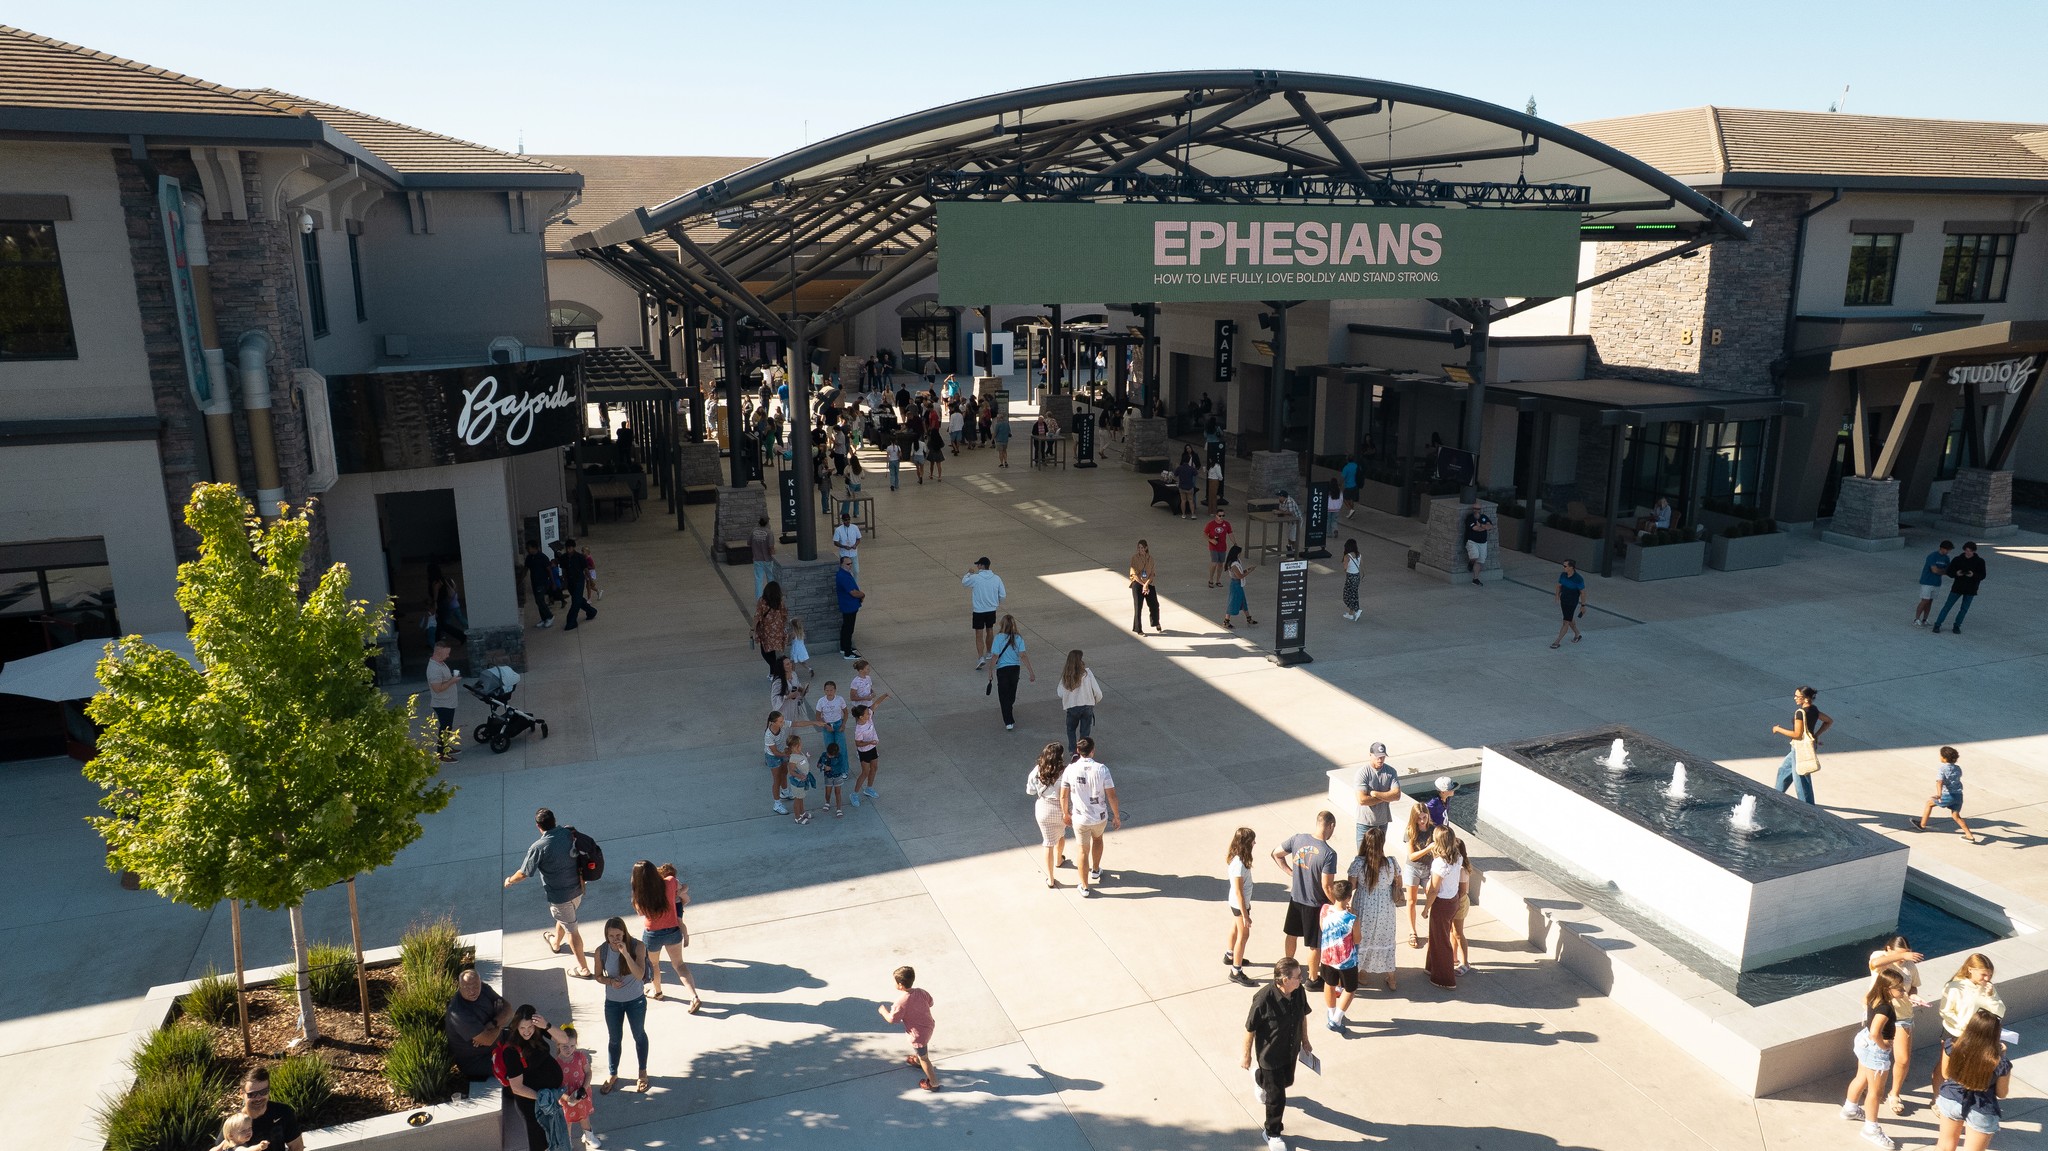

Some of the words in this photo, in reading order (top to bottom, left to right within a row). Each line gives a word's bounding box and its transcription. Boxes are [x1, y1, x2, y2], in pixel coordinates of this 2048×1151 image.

[1154, 221, 1443, 266] EPHESIANS
[1154, 274, 1183, 285] HOW
[1186, 274, 1201, 284] TO
[1204, 273, 1228, 284] LIVE
[1230, 273, 1264, 285] FULLY,
[1266, 273, 1294, 284] LOVE
[1296, 272, 1336, 283] BOLDLY
[1338, 272, 1361, 282] AND
[1363, 272, 1395, 282] STAND
[1397, 271, 1440, 282] STRONG.
[1681, 327, 1692, 345] B
[1711, 328, 1722, 345] B
[1220, 325, 1230, 377] CAFE
[1947, 365, 2012, 385] STUDIO
[457, 374, 577, 446] Bayside
[787, 479, 796, 516] KIDS
